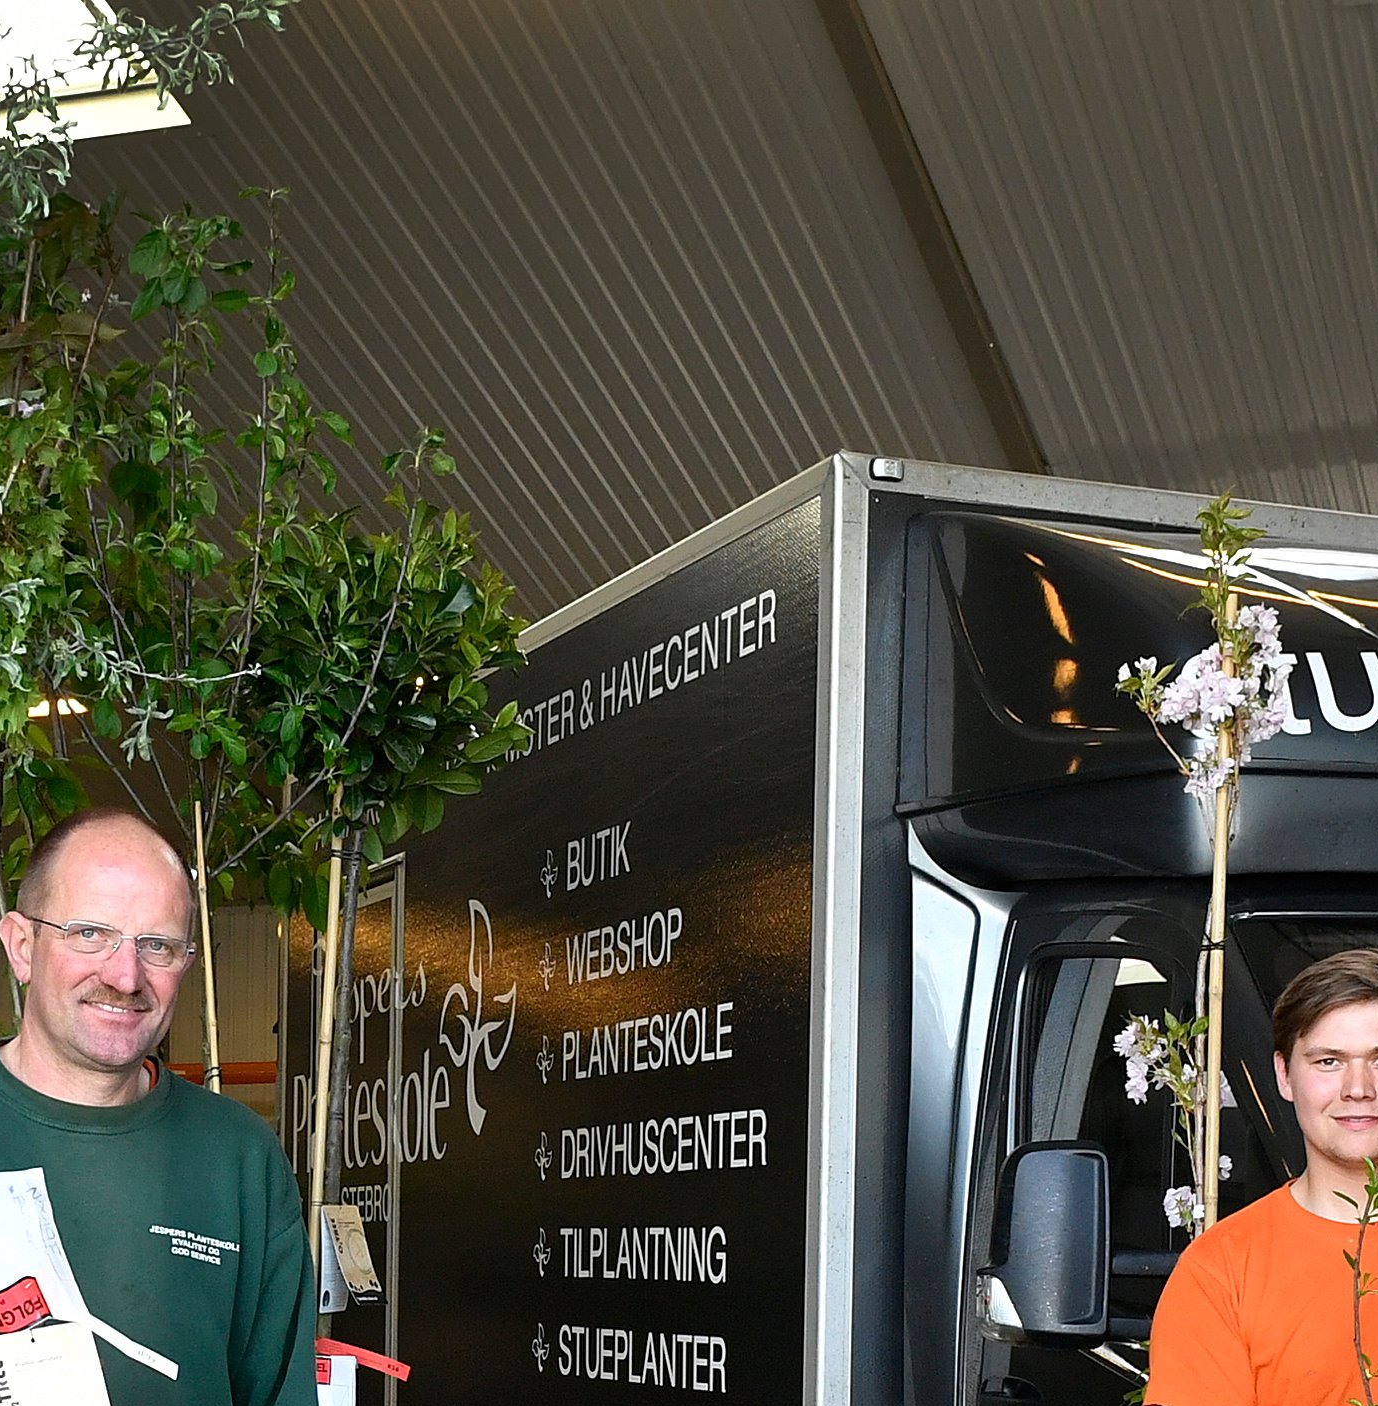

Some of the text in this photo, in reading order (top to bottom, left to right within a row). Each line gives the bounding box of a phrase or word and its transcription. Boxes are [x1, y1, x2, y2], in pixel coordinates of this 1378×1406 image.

[579, 678, 595, 731] &
[600, 588, 777, 722] HAVECENTER
[564, 821, 631, 893] BUTIK
[566, 907, 683, 985] WEBSHOP
[562, 1002, 733, 1083] PLANTESKOLE
[560, 1109, 769, 1181] DRIVHUSCENTER
[560, 1226, 727, 1285] TILPLANTNING
[558, 1323, 728, 1395] STUEPLANTER
